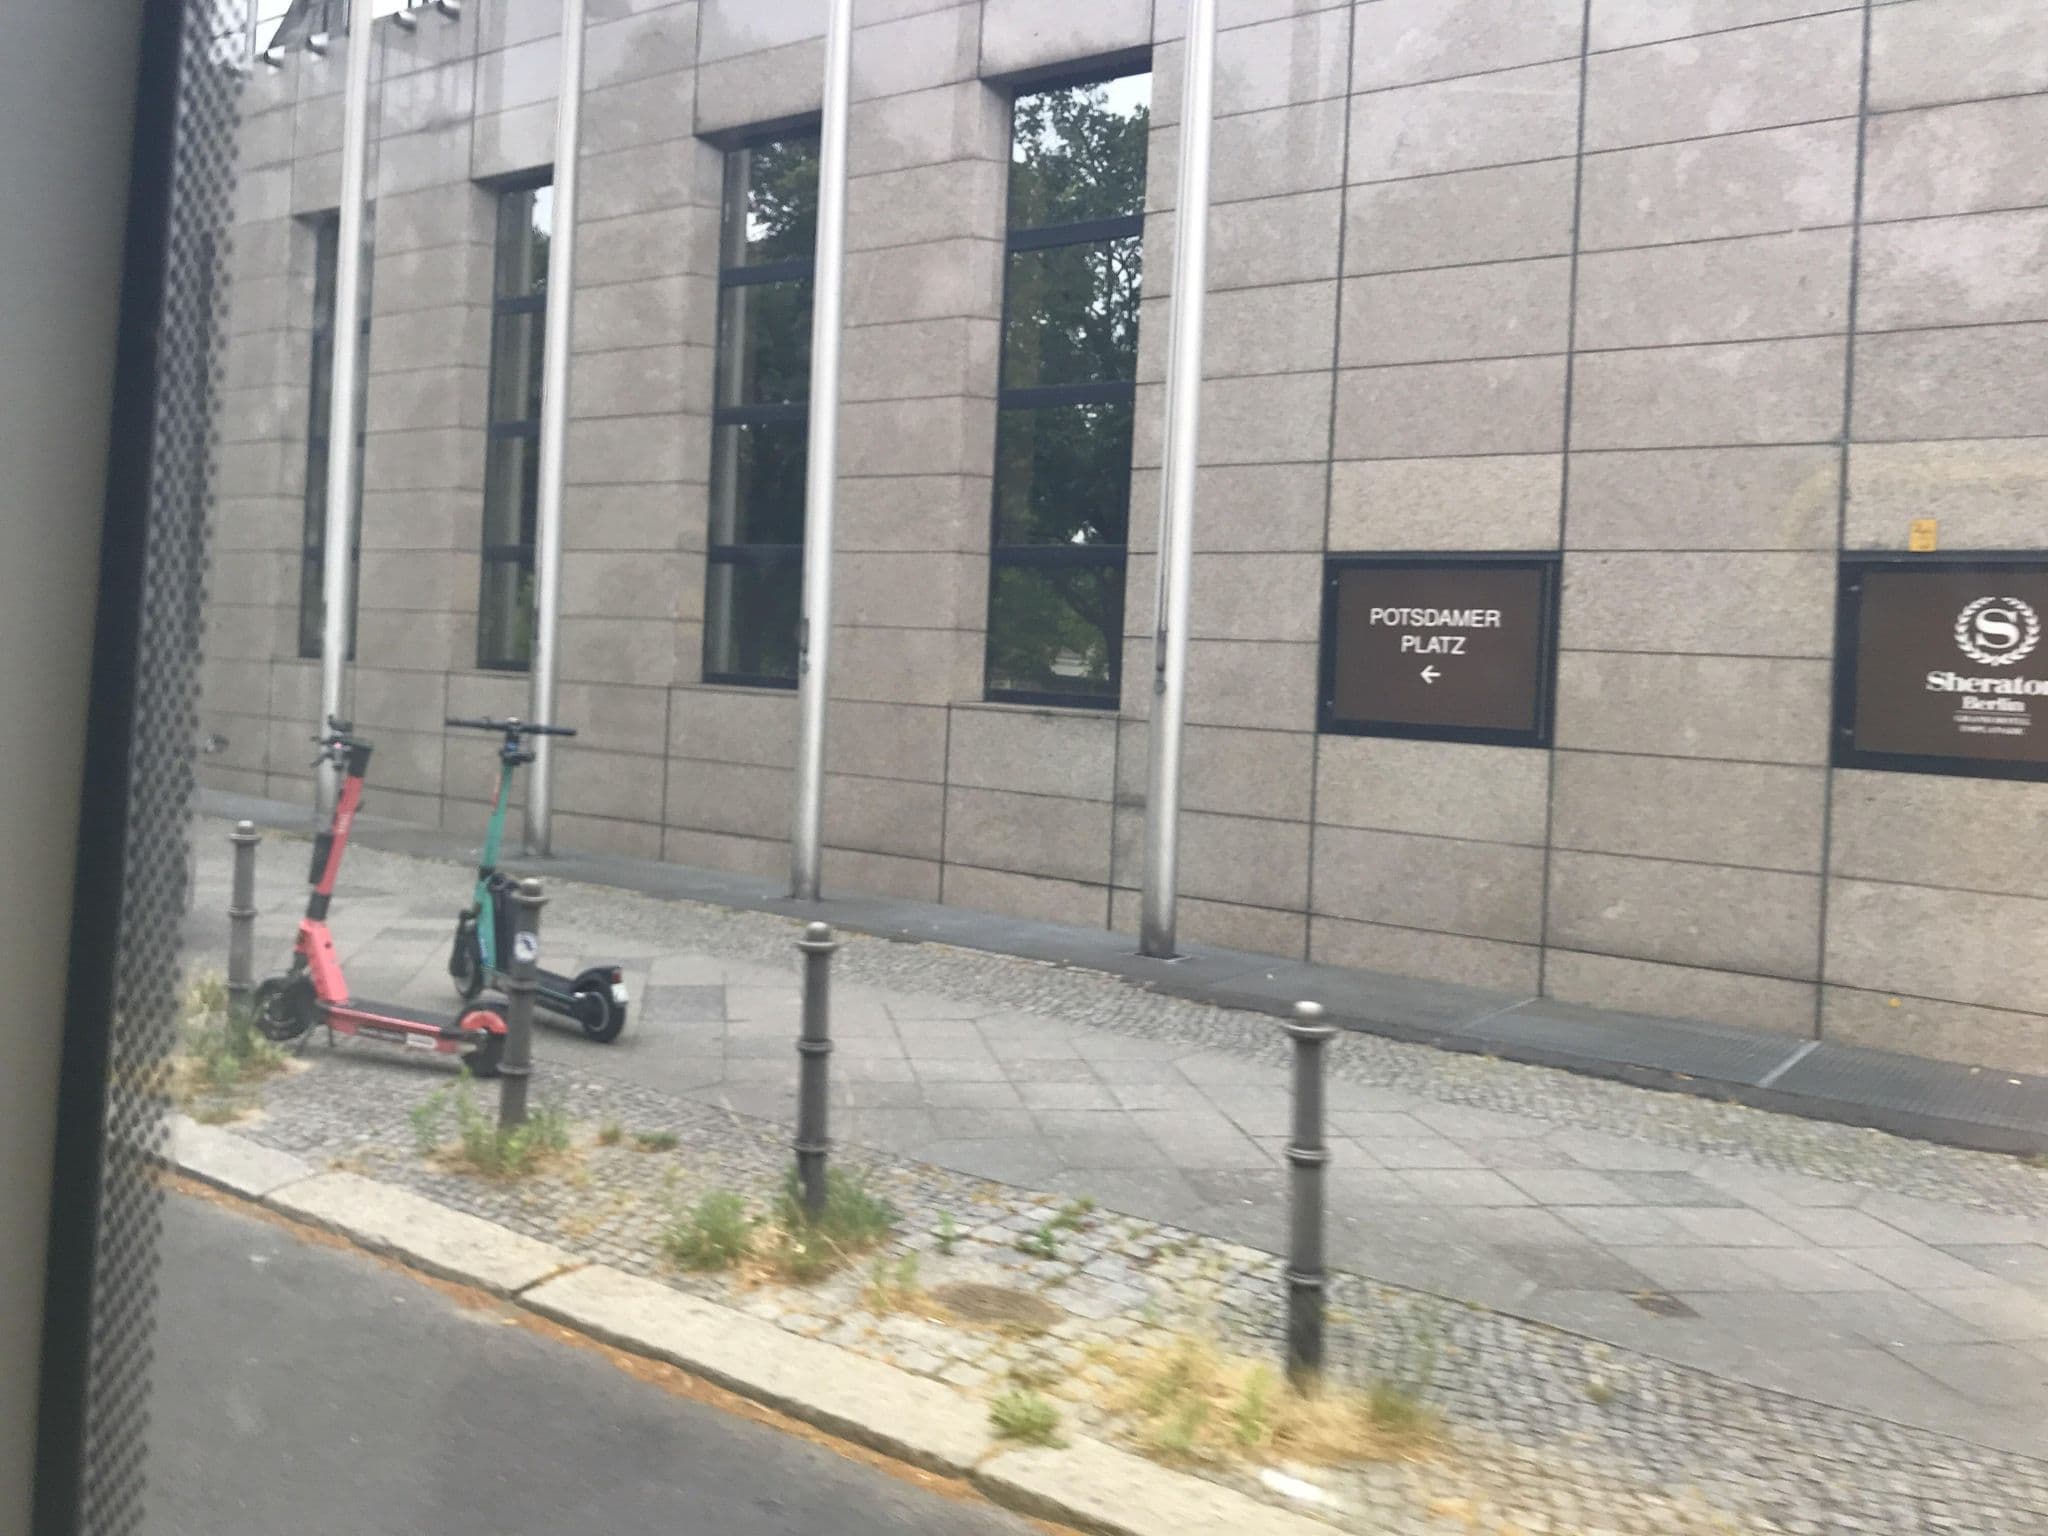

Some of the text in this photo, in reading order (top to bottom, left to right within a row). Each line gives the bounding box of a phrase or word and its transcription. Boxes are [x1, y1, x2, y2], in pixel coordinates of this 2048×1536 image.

[1369, 607, 1501, 628] POTSDAMER
[1975, 608, 2020, 649] S
[1401, 635, 1466, 654] PLATZ
